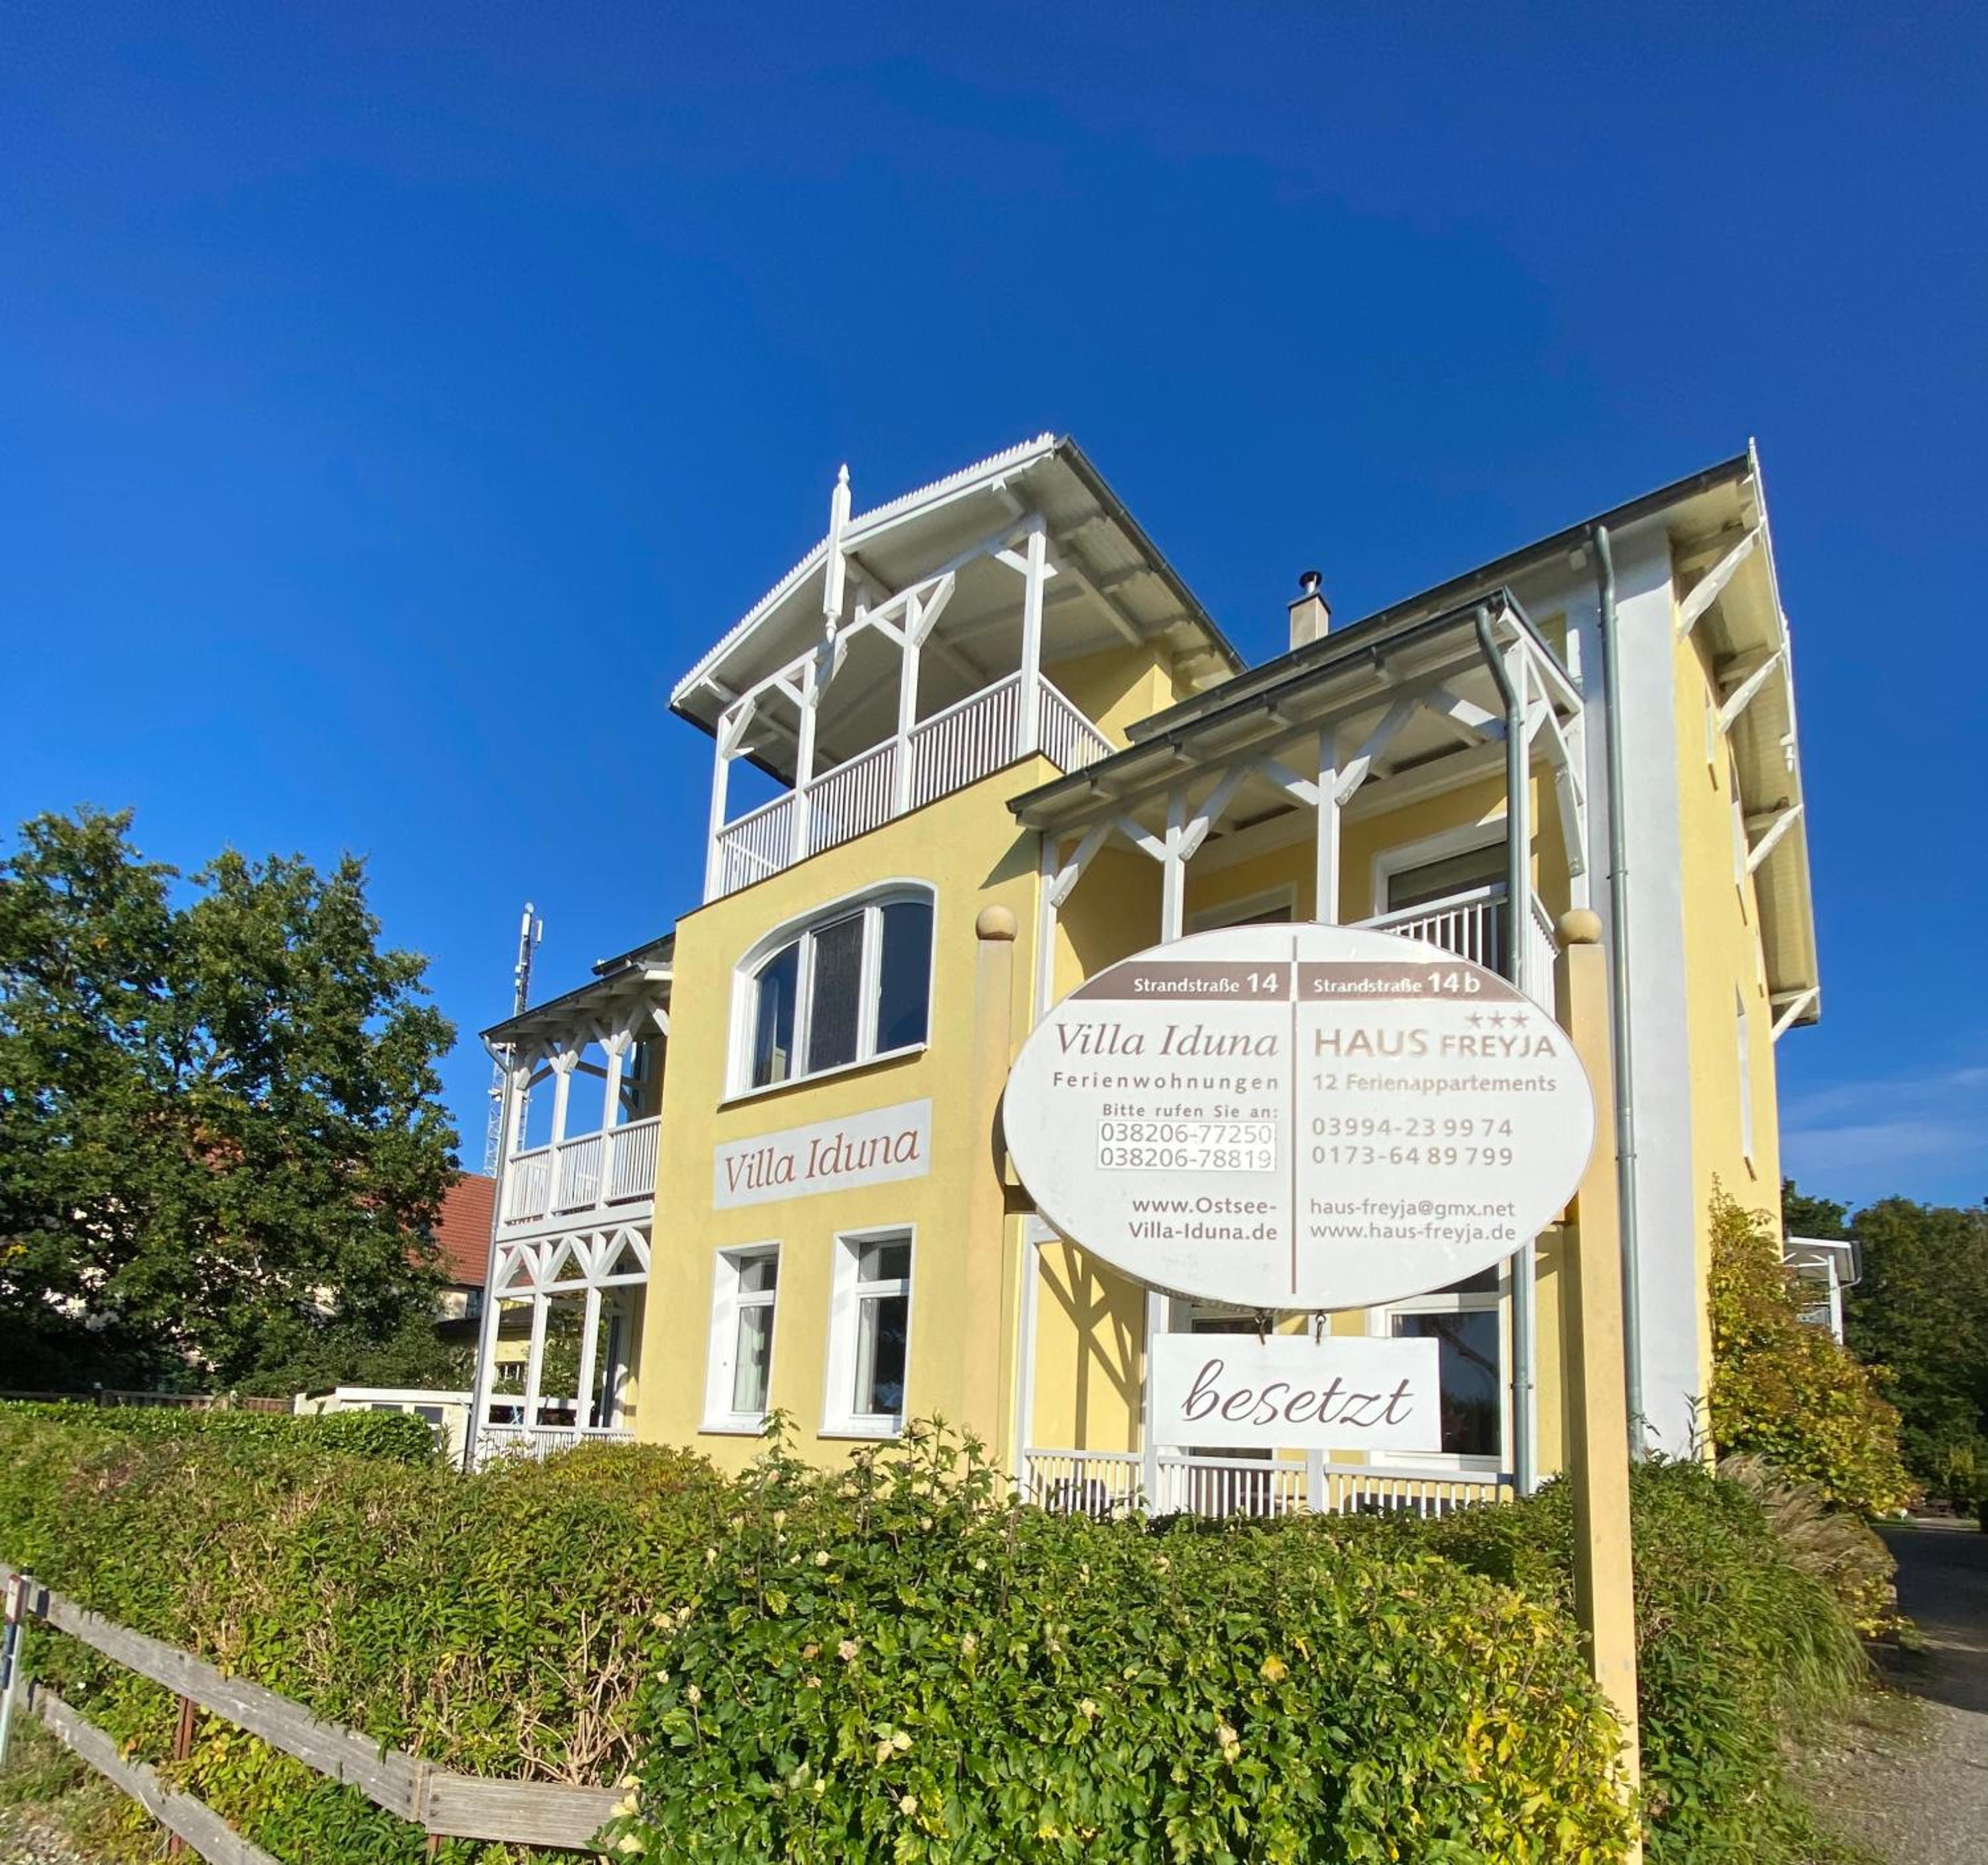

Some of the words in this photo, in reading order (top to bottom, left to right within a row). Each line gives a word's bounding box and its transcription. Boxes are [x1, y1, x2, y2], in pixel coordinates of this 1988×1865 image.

[1134, 977, 1240, 993] Strandstraße
[1246, 972, 1279, 993] 14
[1313, 978, 1422, 993] Strandstraße
[1056, 1023, 1145, 1056] Villa
[1158, 1024, 1280, 1056] Iduna
[1314, 1028, 1429, 1058] HAUS
[1440, 1035, 1557, 1058] FREYJA
[1053, 1071, 1279, 1094] Ferienwohnungen
[1313, 1073, 1338, 1091] 12
[1345, 1073, 1557, 1096] Ferienappartements
[1102, 1103, 1146, 1117] Bitte
[1156, 1103, 1203, 1118] rufen
[1214, 1105, 1240, 1118] Sie
[1250, 1106, 1279, 1119] an:
[1101, 1122, 1272, 1145] 038206-77250
[725, 1145, 796, 1193] Villa
[805, 1129, 921, 1180] Iduna
[1101, 1147, 1272, 1169] 038206-78819
[1132, 1196, 1278, 1215] www.Ostsee-
[1310, 1198, 1516, 1219] haus-freyja@gmx.net
[1129, 1221, 1278, 1241] Villa-Iduna.de
[1310, 1221, 1516, 1244] www.haus-freyja.de
[1180, 1358, 1417, 1428] besetzt
